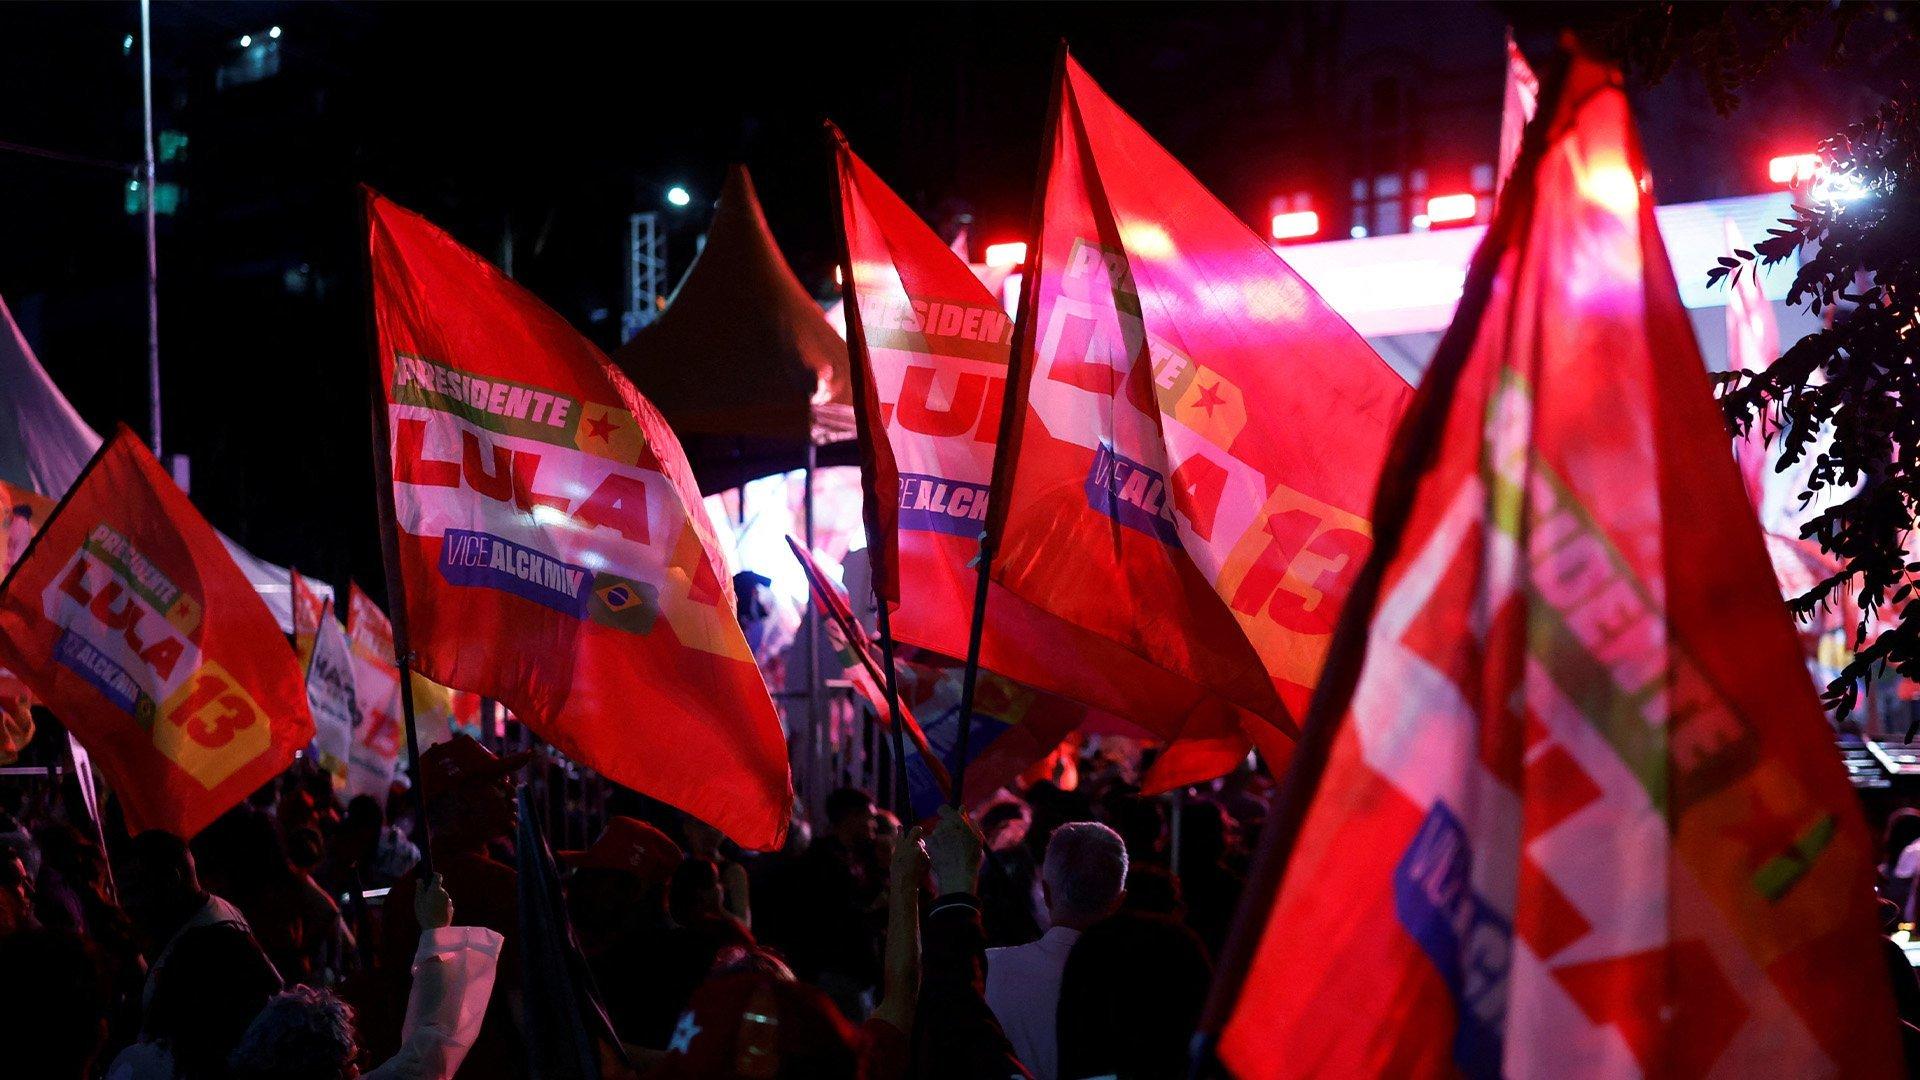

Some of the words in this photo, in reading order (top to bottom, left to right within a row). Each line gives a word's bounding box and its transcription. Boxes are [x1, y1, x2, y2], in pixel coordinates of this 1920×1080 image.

[397, 355, 571, 429] PRESIDENTE
[393, 418, 650, 546] LULA
[448, 534, 491, 568] VICE
[489, 542, 585, 599] ALCKMIN
[1230, 509, 1374, 635] 13
[59, 558, 184, 682] LULA
[170, 675, 256, 748] 13
